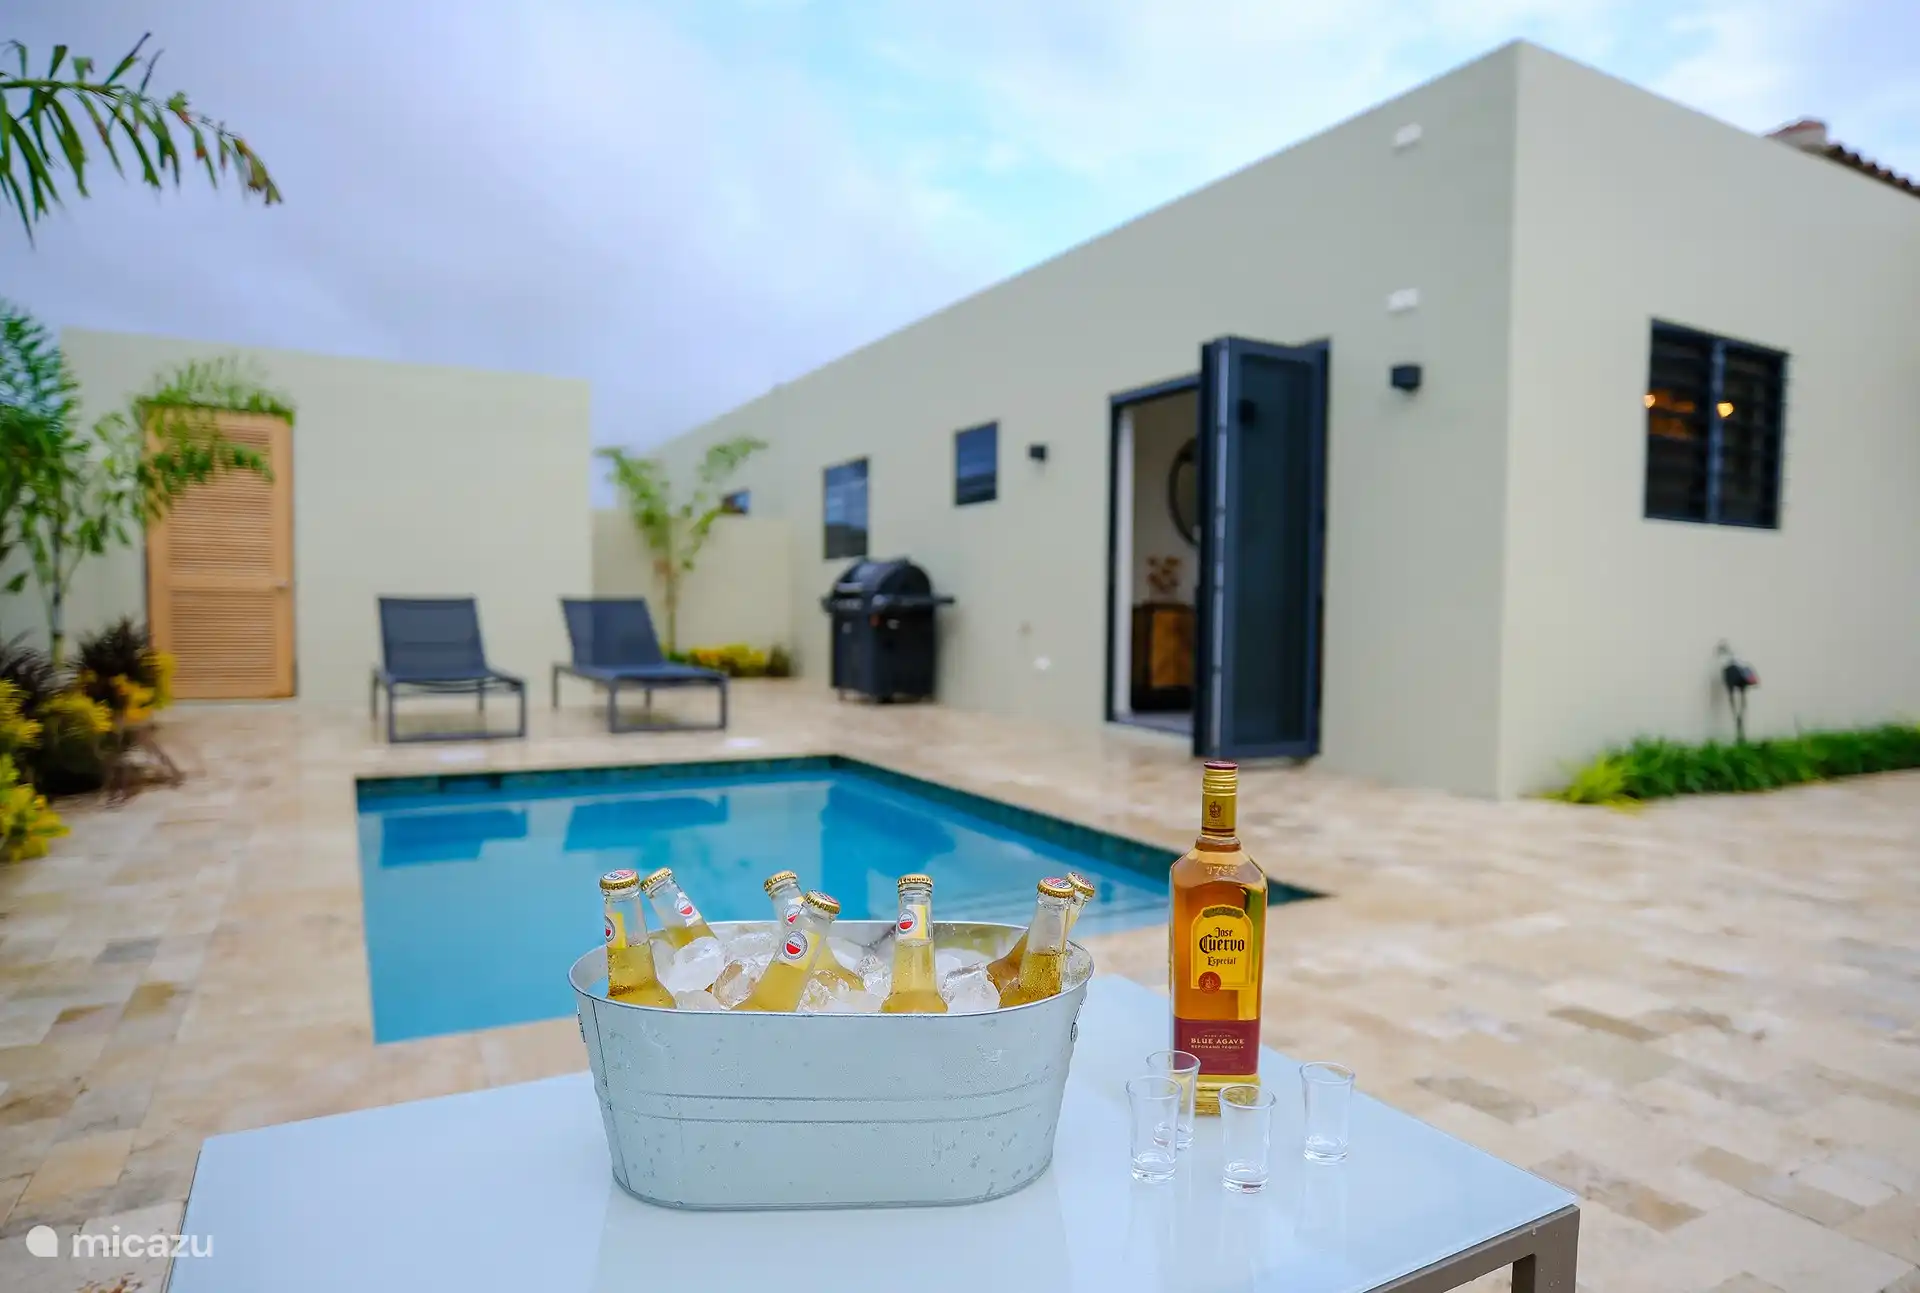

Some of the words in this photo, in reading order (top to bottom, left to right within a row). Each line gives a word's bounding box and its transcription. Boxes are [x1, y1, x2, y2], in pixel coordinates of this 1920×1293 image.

[1214, 927, 1233, 938] Jose
[1199, 934, 1245, 954] Cuervo
[1207, 956, 1236, 967] Especial
[1190, 1037, 1214, 1045] BLUE
